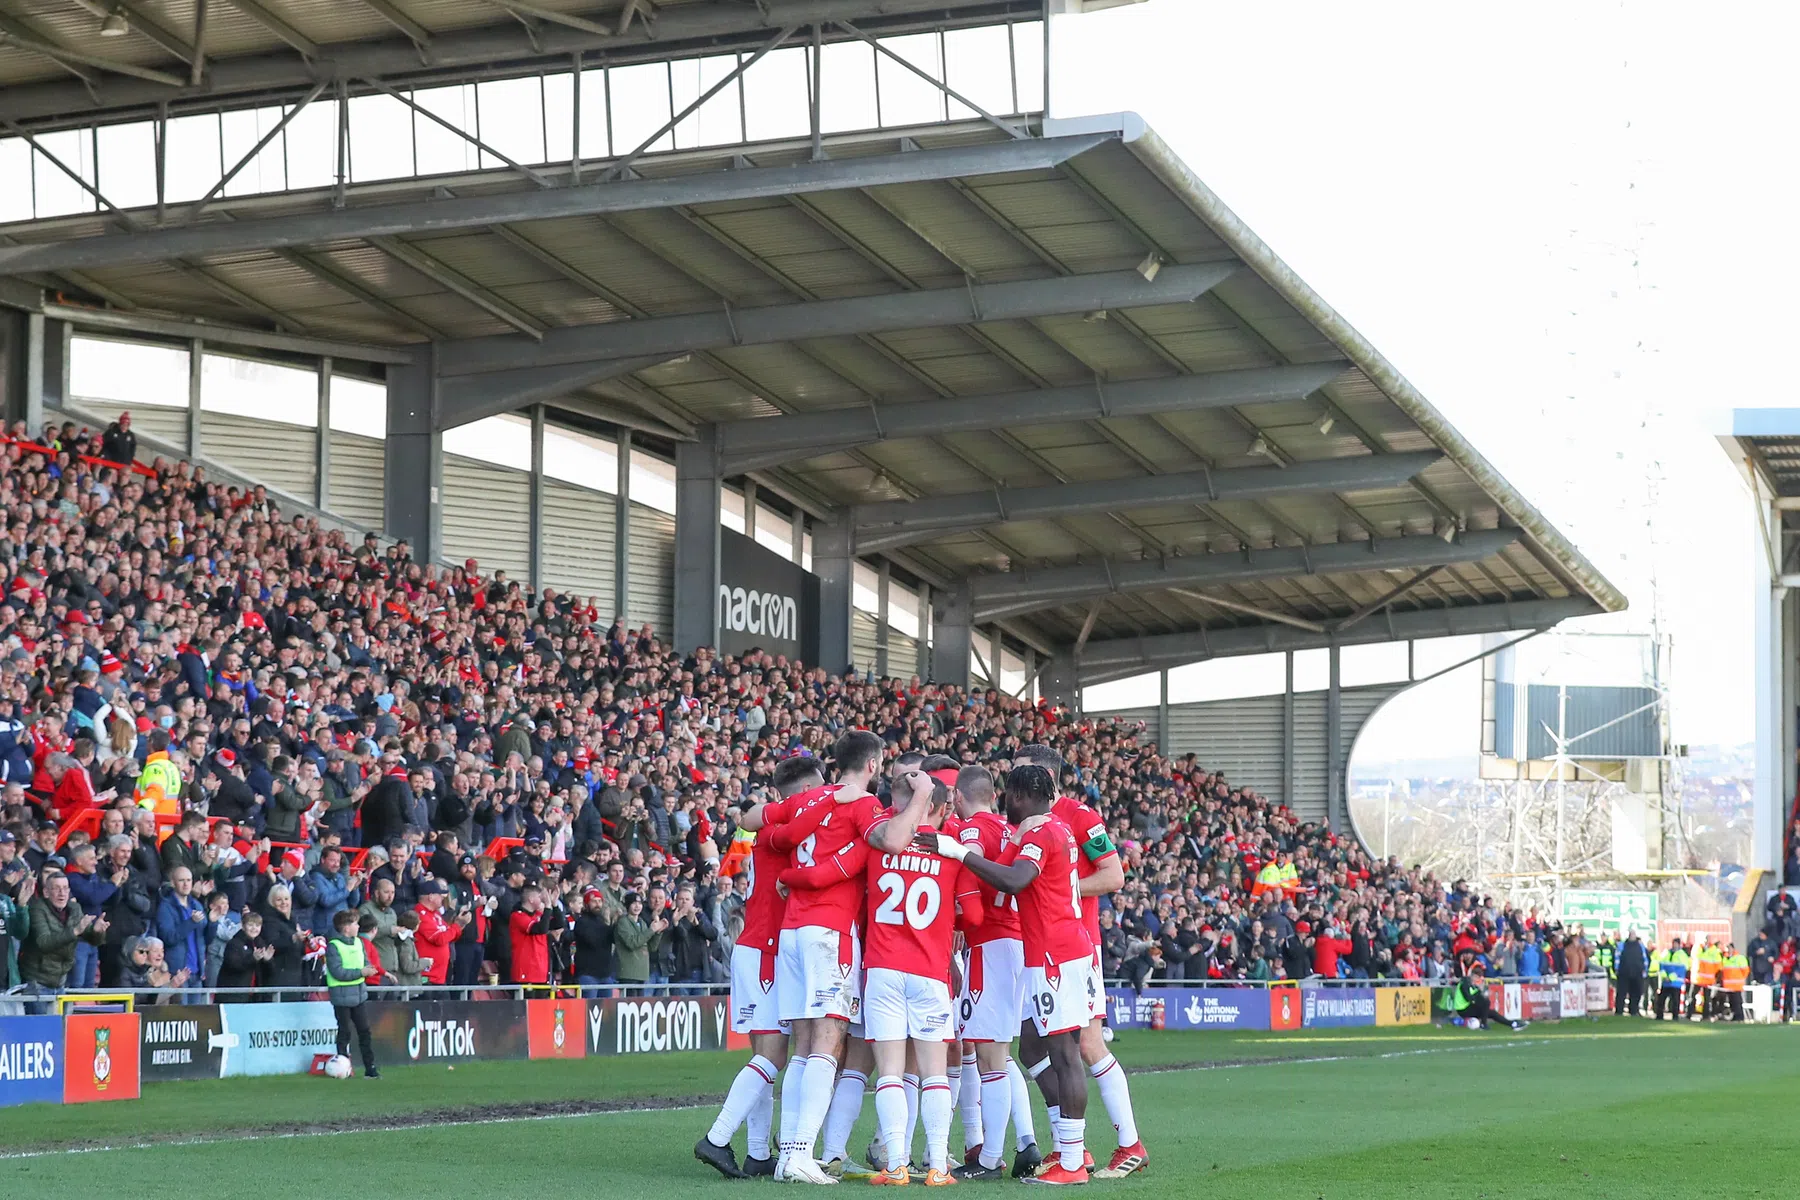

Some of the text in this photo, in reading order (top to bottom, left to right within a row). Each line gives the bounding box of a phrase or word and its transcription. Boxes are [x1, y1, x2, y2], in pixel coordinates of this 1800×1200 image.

[881, 853, 941, 876] CANNON
[875, 871, 941, 931] 20
[1032, 992, 1055, 1017] 19
[1203, 998, 1219, 1006] THE
[1203, 1006, 1240, 1015] NATIONAL
[1402, 993, 1426, 1020] Expedia
[616, 1000, 701, 1054] macron
[1203, 1014, 1238, 1023] LOTTERY
[145, 1020, 198, 1044] AVIATION
[248, 1030, 299, 1049] NON-STOP
[425, 1020, 475, 1057] TikTok
[0, 1041, 55, 1081] AILERS
[152, 1049, 180, 1065] AMERICAN
